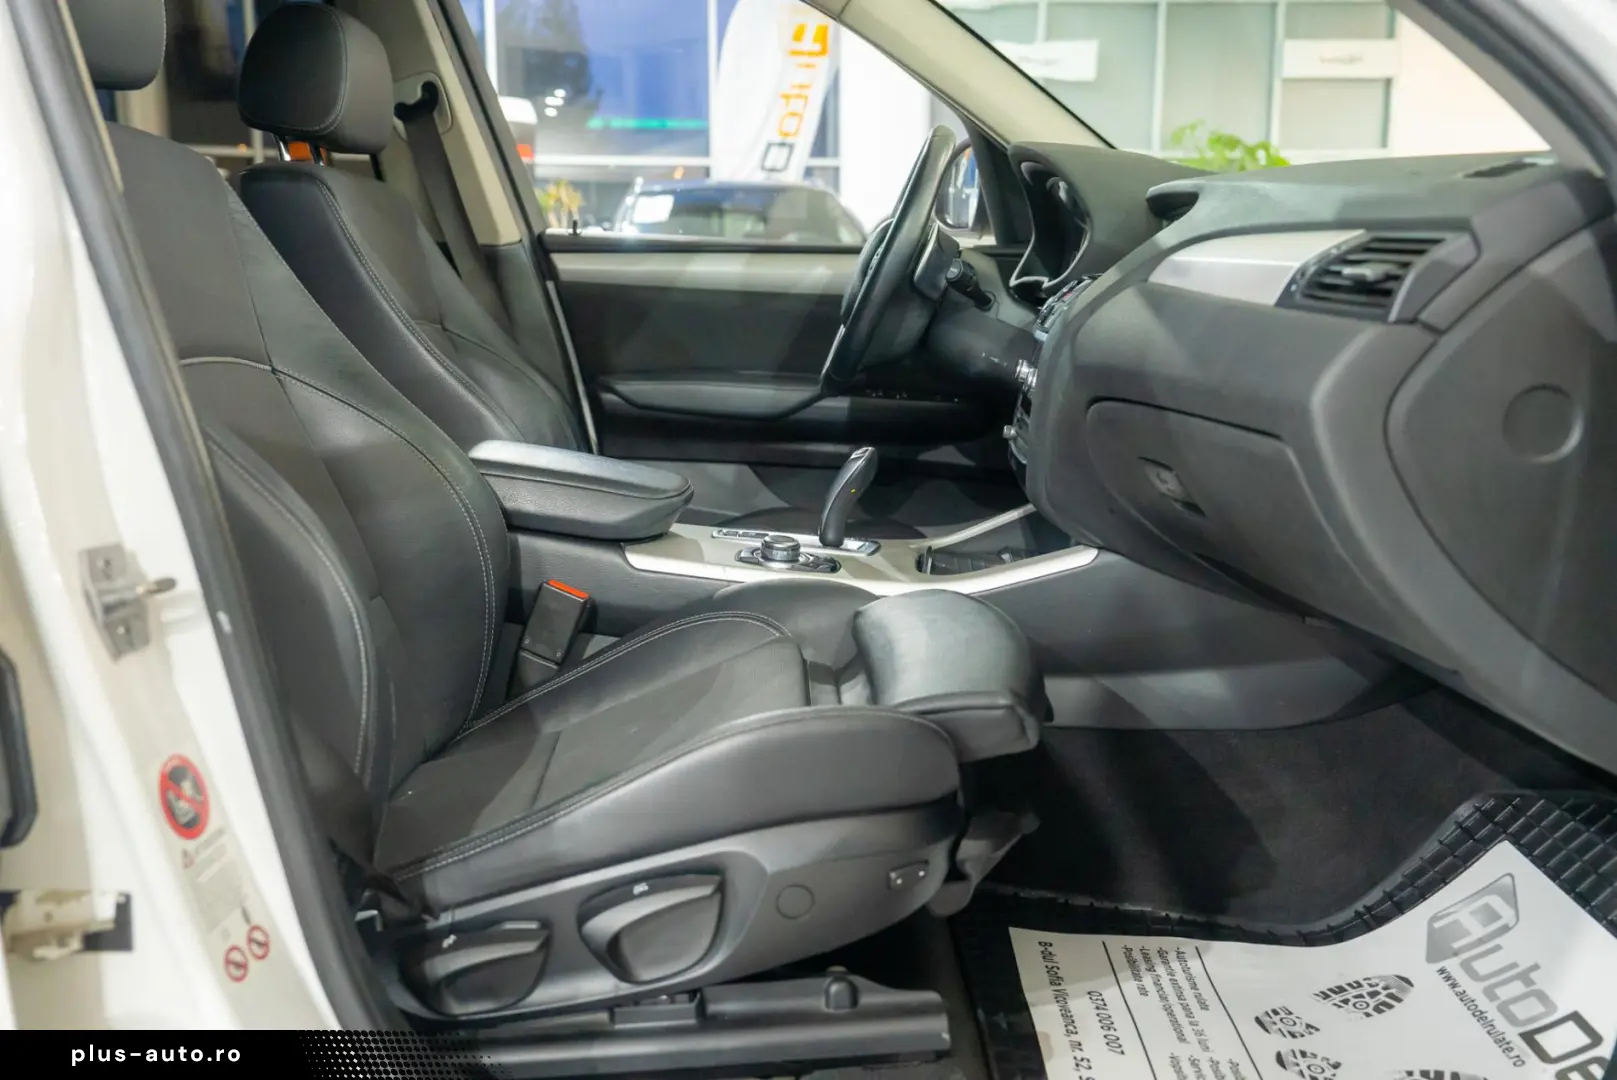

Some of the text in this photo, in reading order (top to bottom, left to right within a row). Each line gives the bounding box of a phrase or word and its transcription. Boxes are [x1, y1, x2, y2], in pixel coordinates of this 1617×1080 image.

[1038, 941, 1059, 963] B-dul
[1139, 945, 1157, 972] -Leasing
[1045, 963, 1065, 986] Sofia
[1174, 946, 1199, 991] -Autoturisme
[1136, 983, 1149, 997] rate
[1157, 947, 1177, 977] -Garantie
[1178, 1002, 1195, 1019] pana
[1052, 987, 1079, 1038] Vicoveanca,
[1087, 990, 1126, 1056] 0374 006 007
[1435, 966, 1527, 1069] www.autodelrulate.ro
[1068, 1039, 1084, 1053] nr.
[1072, 1055, 1092, 1072] 52,
